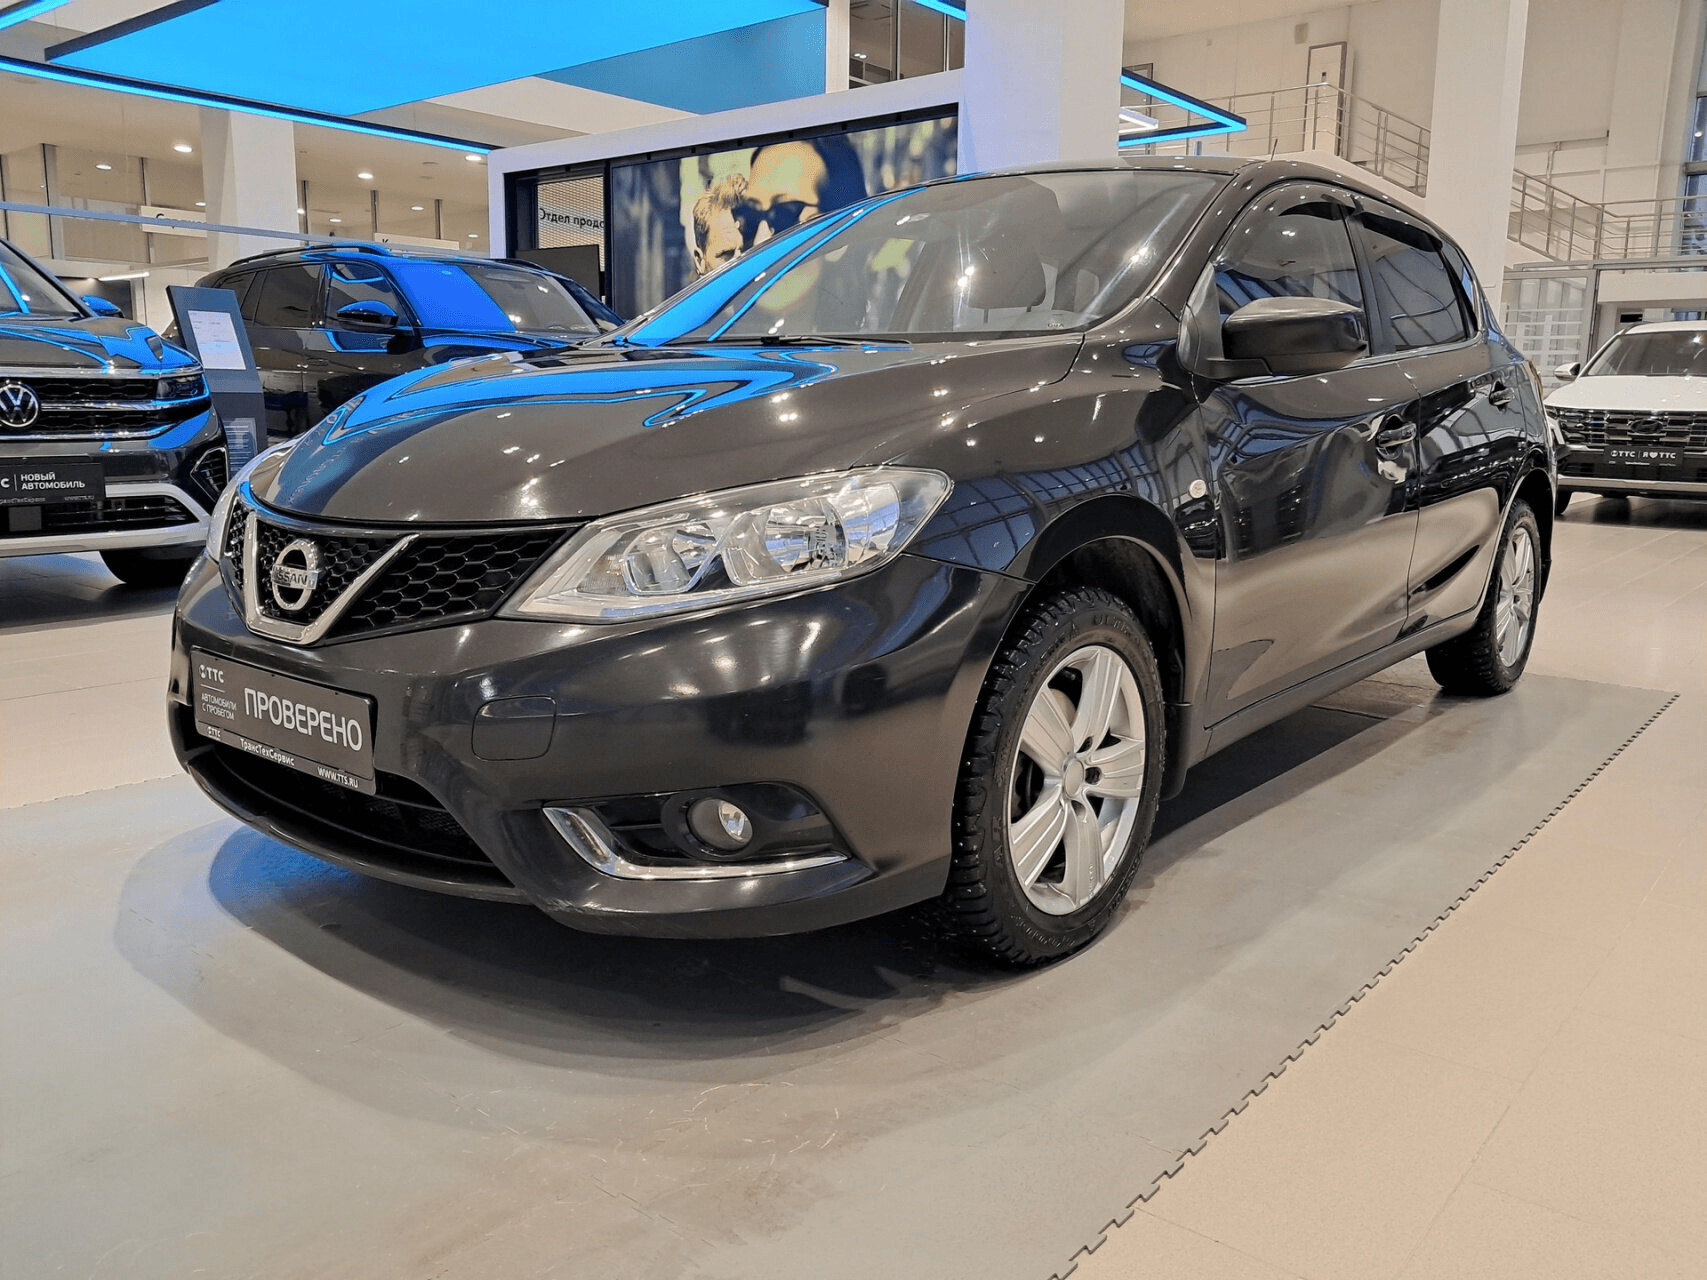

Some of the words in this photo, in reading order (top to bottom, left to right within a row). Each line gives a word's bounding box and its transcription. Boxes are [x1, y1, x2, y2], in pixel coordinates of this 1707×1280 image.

[20, 472, 56, 482] НОВЫЙ
[21, 481, 86, 490] АВТОМОБИЛЬ
[201, 692, 237, 711] АВТОМОБИЛИ
[202, 702, 207, 712] С
[207, 704, 235, 720] ПРОБЕГОМ
[244, 687, 363, 751] ПРОВЕРЕНО
[240, 738, 295, 766] ТрансТехСервис
[317, 766, 358, 789] WWW.TTS.RU
